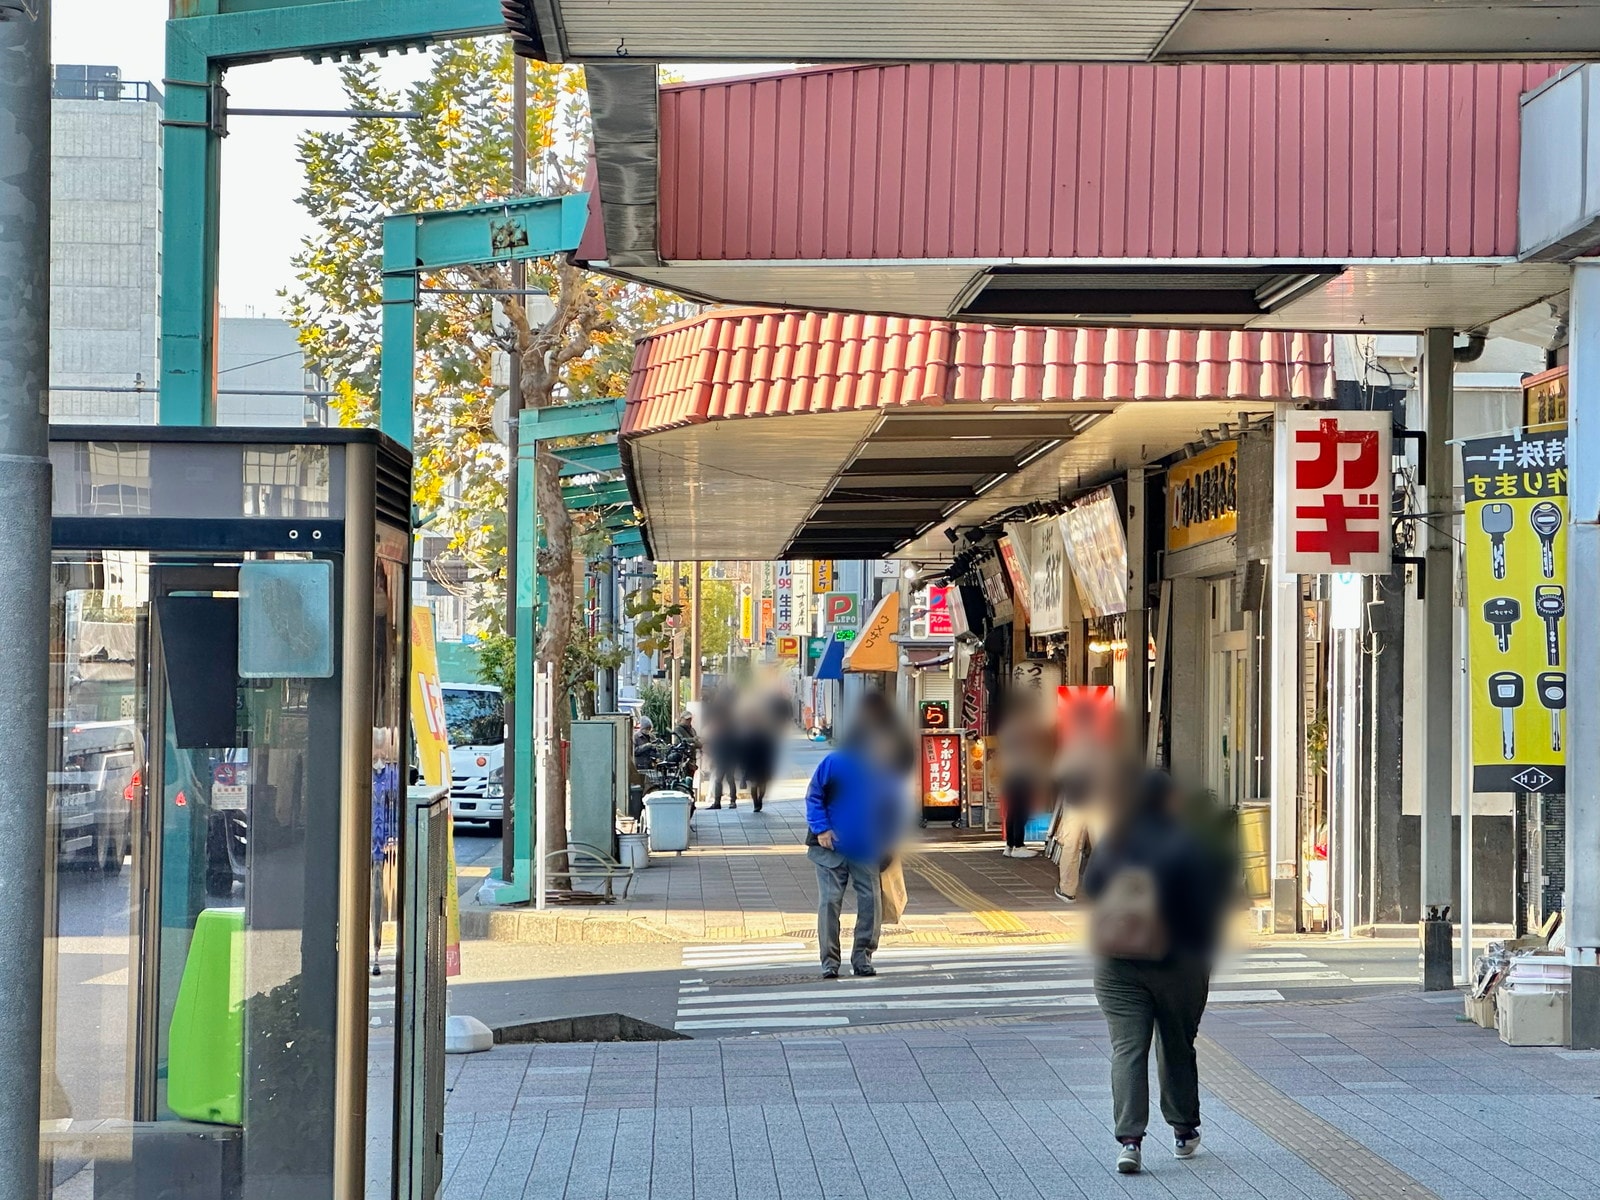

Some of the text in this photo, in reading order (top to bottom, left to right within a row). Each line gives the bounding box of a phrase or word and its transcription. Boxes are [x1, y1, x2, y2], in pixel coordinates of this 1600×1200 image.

[1296, 418, 1379, 565] カギ
[780, 638, 797, 653] P
[926, 706, 944, 724] ら
[929, 763, 941, 792] 専門店
[940, 738, 954, 792] ナポリタン
